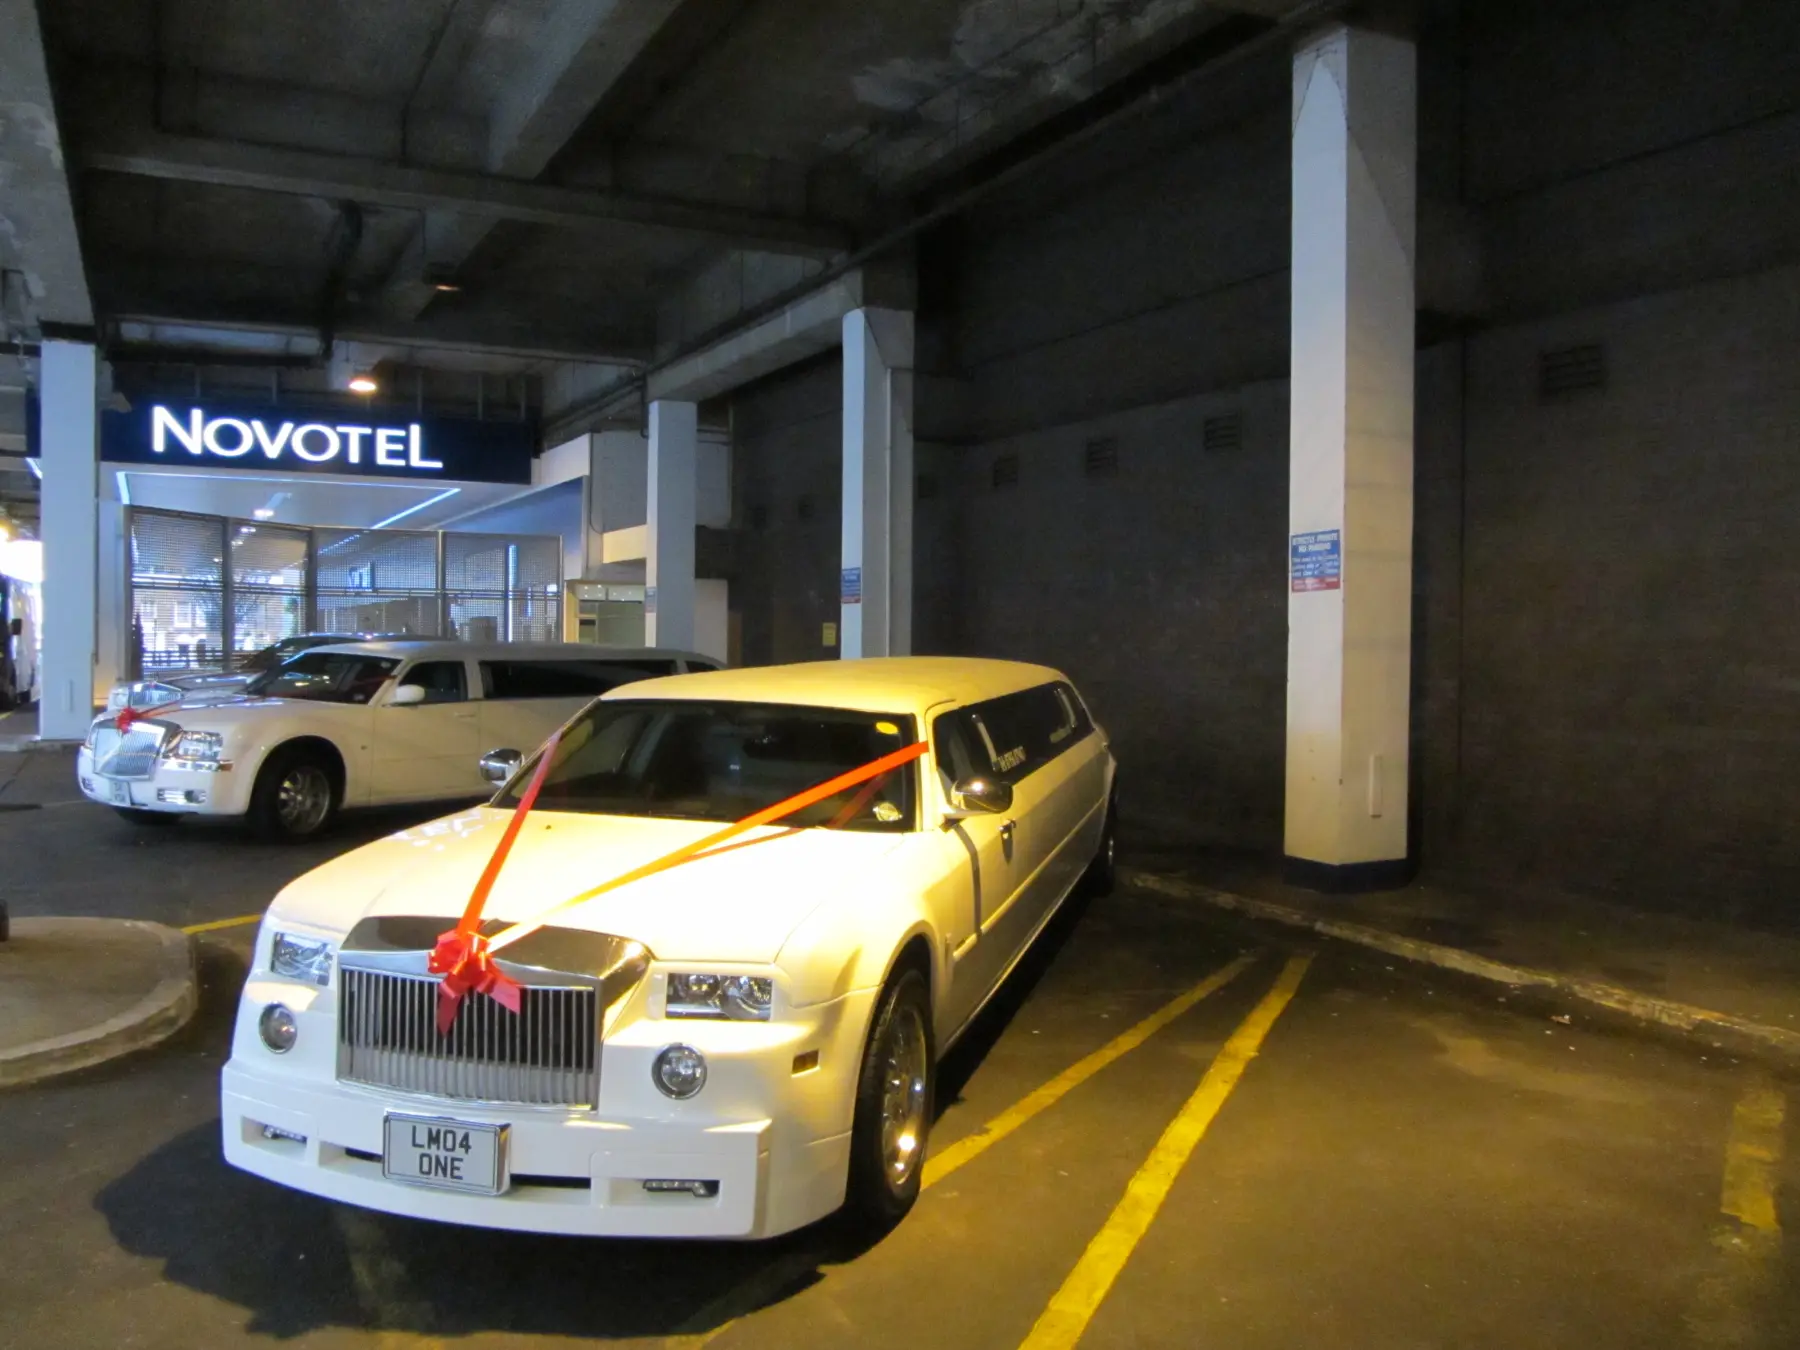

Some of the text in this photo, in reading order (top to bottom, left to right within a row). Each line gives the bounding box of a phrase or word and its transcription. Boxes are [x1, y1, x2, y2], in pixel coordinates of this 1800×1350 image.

[153, 405, 443, 468] NOVOTEL
[412, 1125, 471, 1154] LM04
[419, 1152, 463, 1180] ONE
